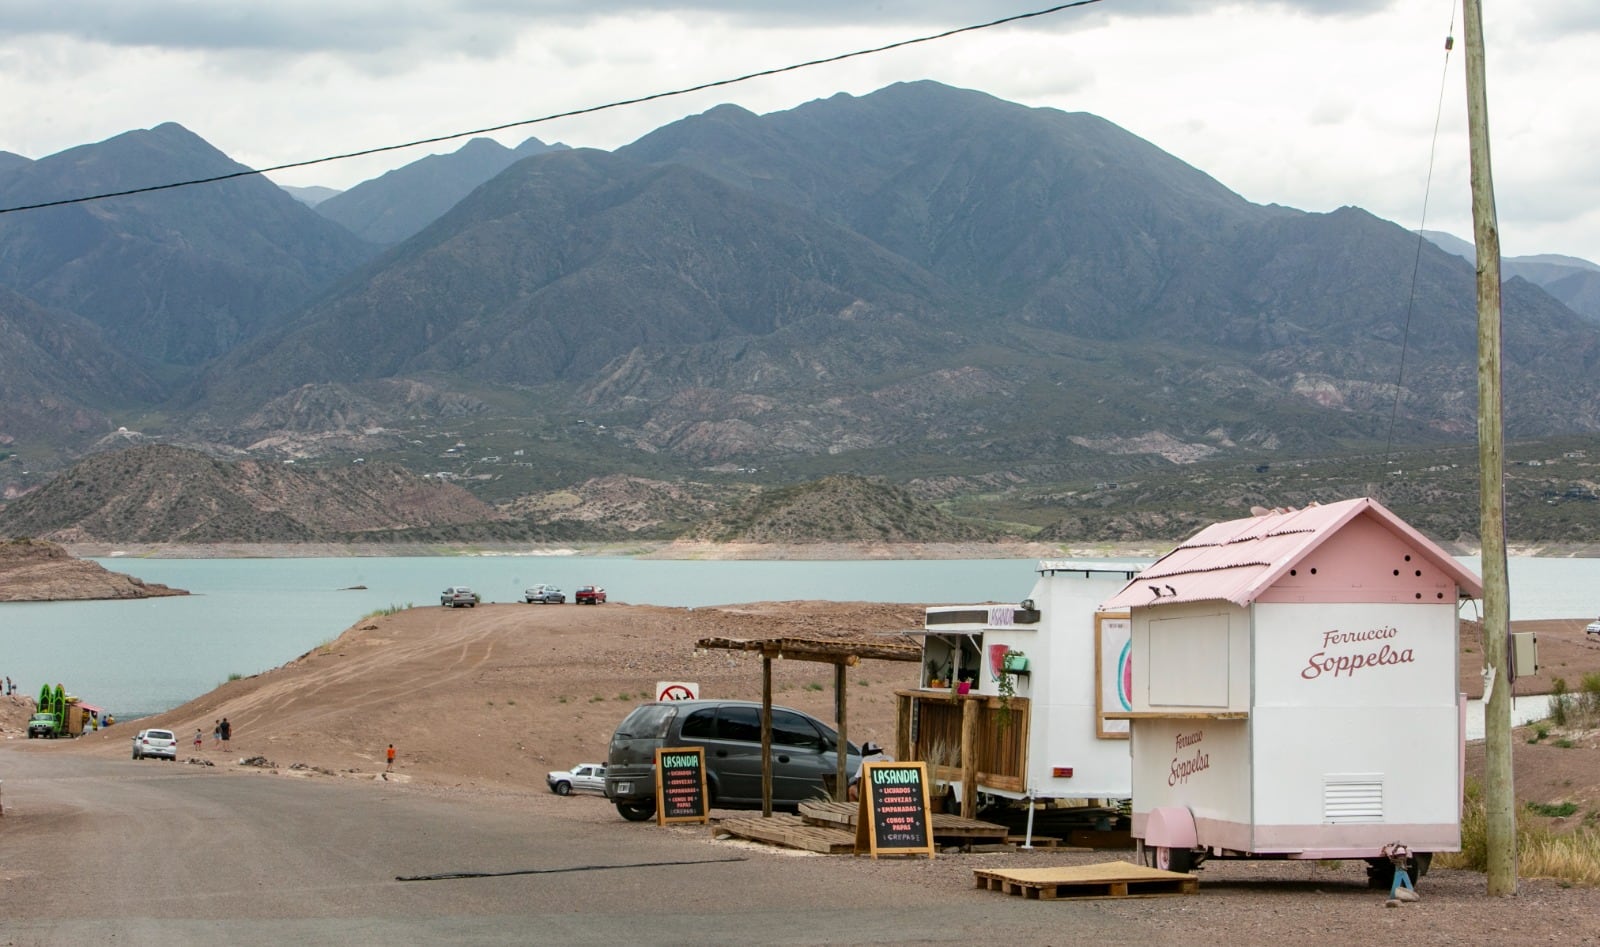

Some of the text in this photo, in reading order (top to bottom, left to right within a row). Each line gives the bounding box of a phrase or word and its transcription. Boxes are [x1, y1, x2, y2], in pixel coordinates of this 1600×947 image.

[1322, 625, 1399, 649] Ferruccio
[1300, 644, 1416, 680] Soppelsa
[1175, 729, 1204, 754] Ferruccio
[1168, 749, 1211, 787] Soppelsa
